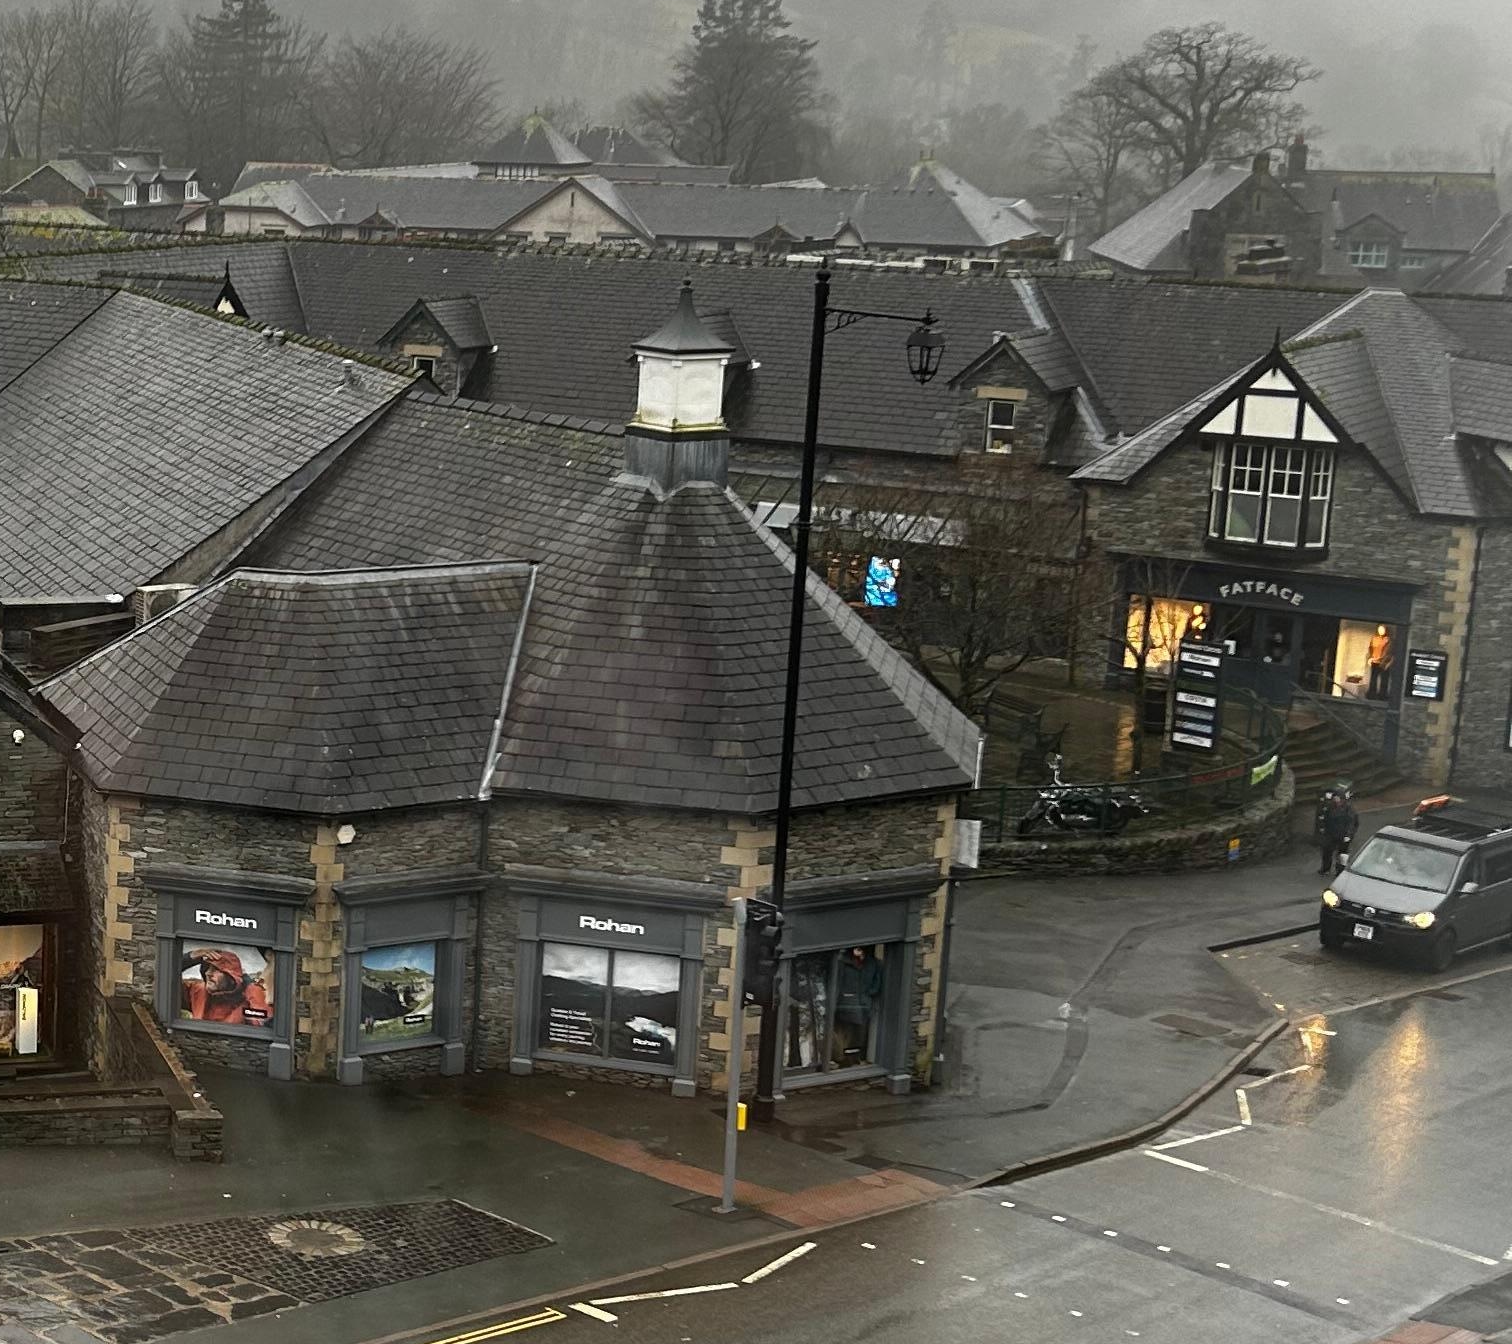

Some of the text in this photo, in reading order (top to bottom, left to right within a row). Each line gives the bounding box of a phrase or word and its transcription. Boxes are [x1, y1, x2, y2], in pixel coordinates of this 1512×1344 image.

[1219, 581, 1305, 606] FATFACE
[195, 909, 257, 929] Rohan
[579, 915, 645, 935] Rohan
